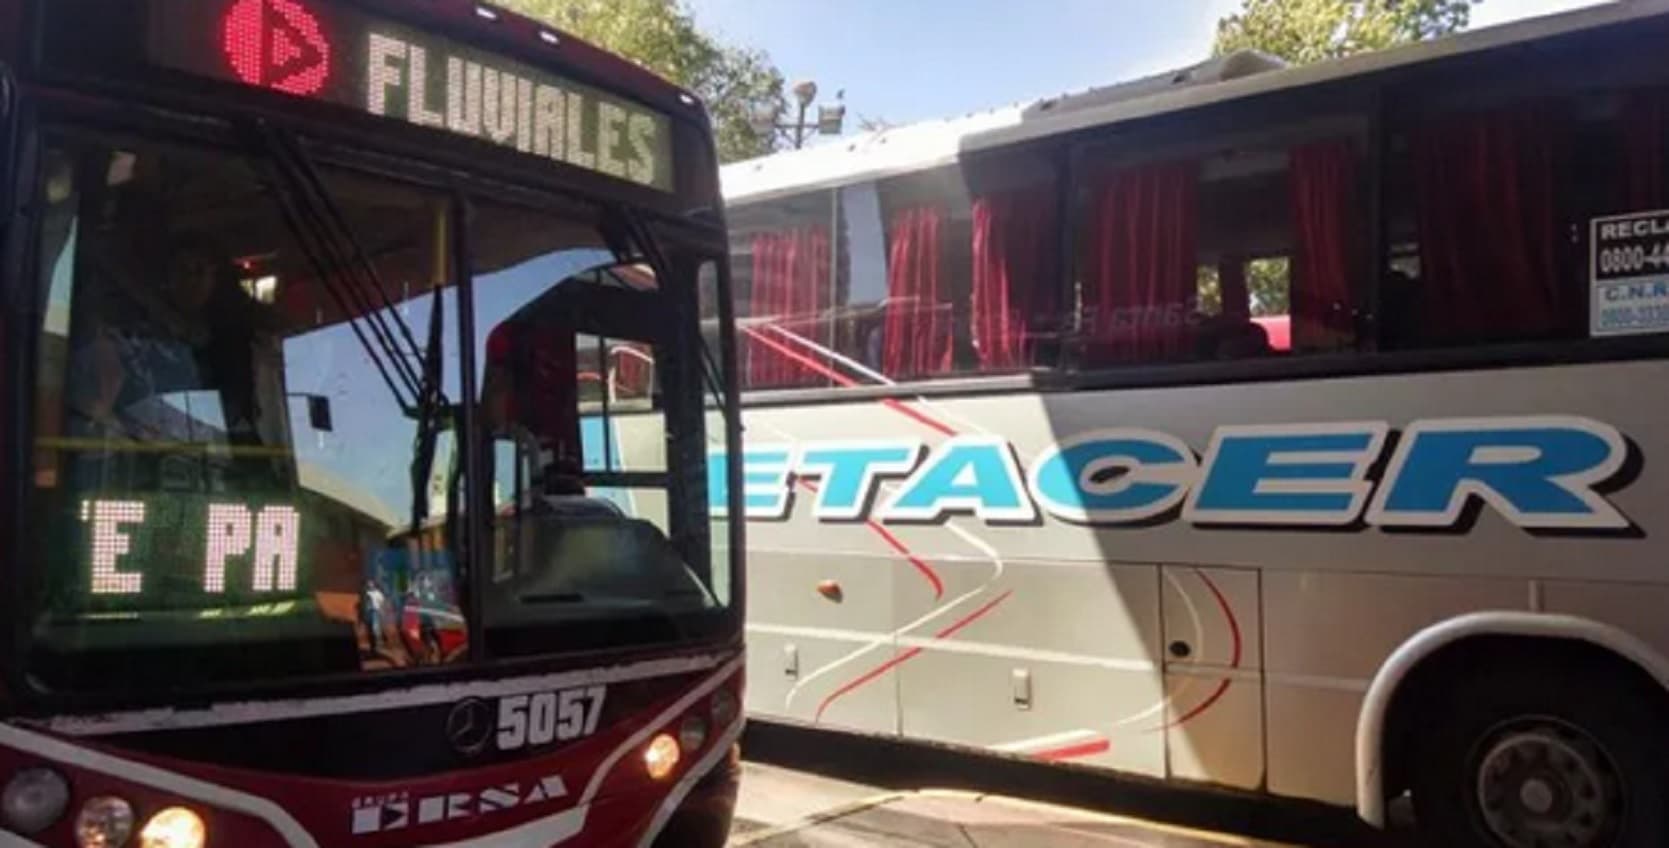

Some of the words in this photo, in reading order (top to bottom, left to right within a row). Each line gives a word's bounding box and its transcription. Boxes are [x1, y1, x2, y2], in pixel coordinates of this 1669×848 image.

[367, 33, 657, 184] FLUVIALES
[707, 414, 1634, 530] ETACER
[204, 503, 300, 593] PA
[496, 684, 606, 750] 5057
